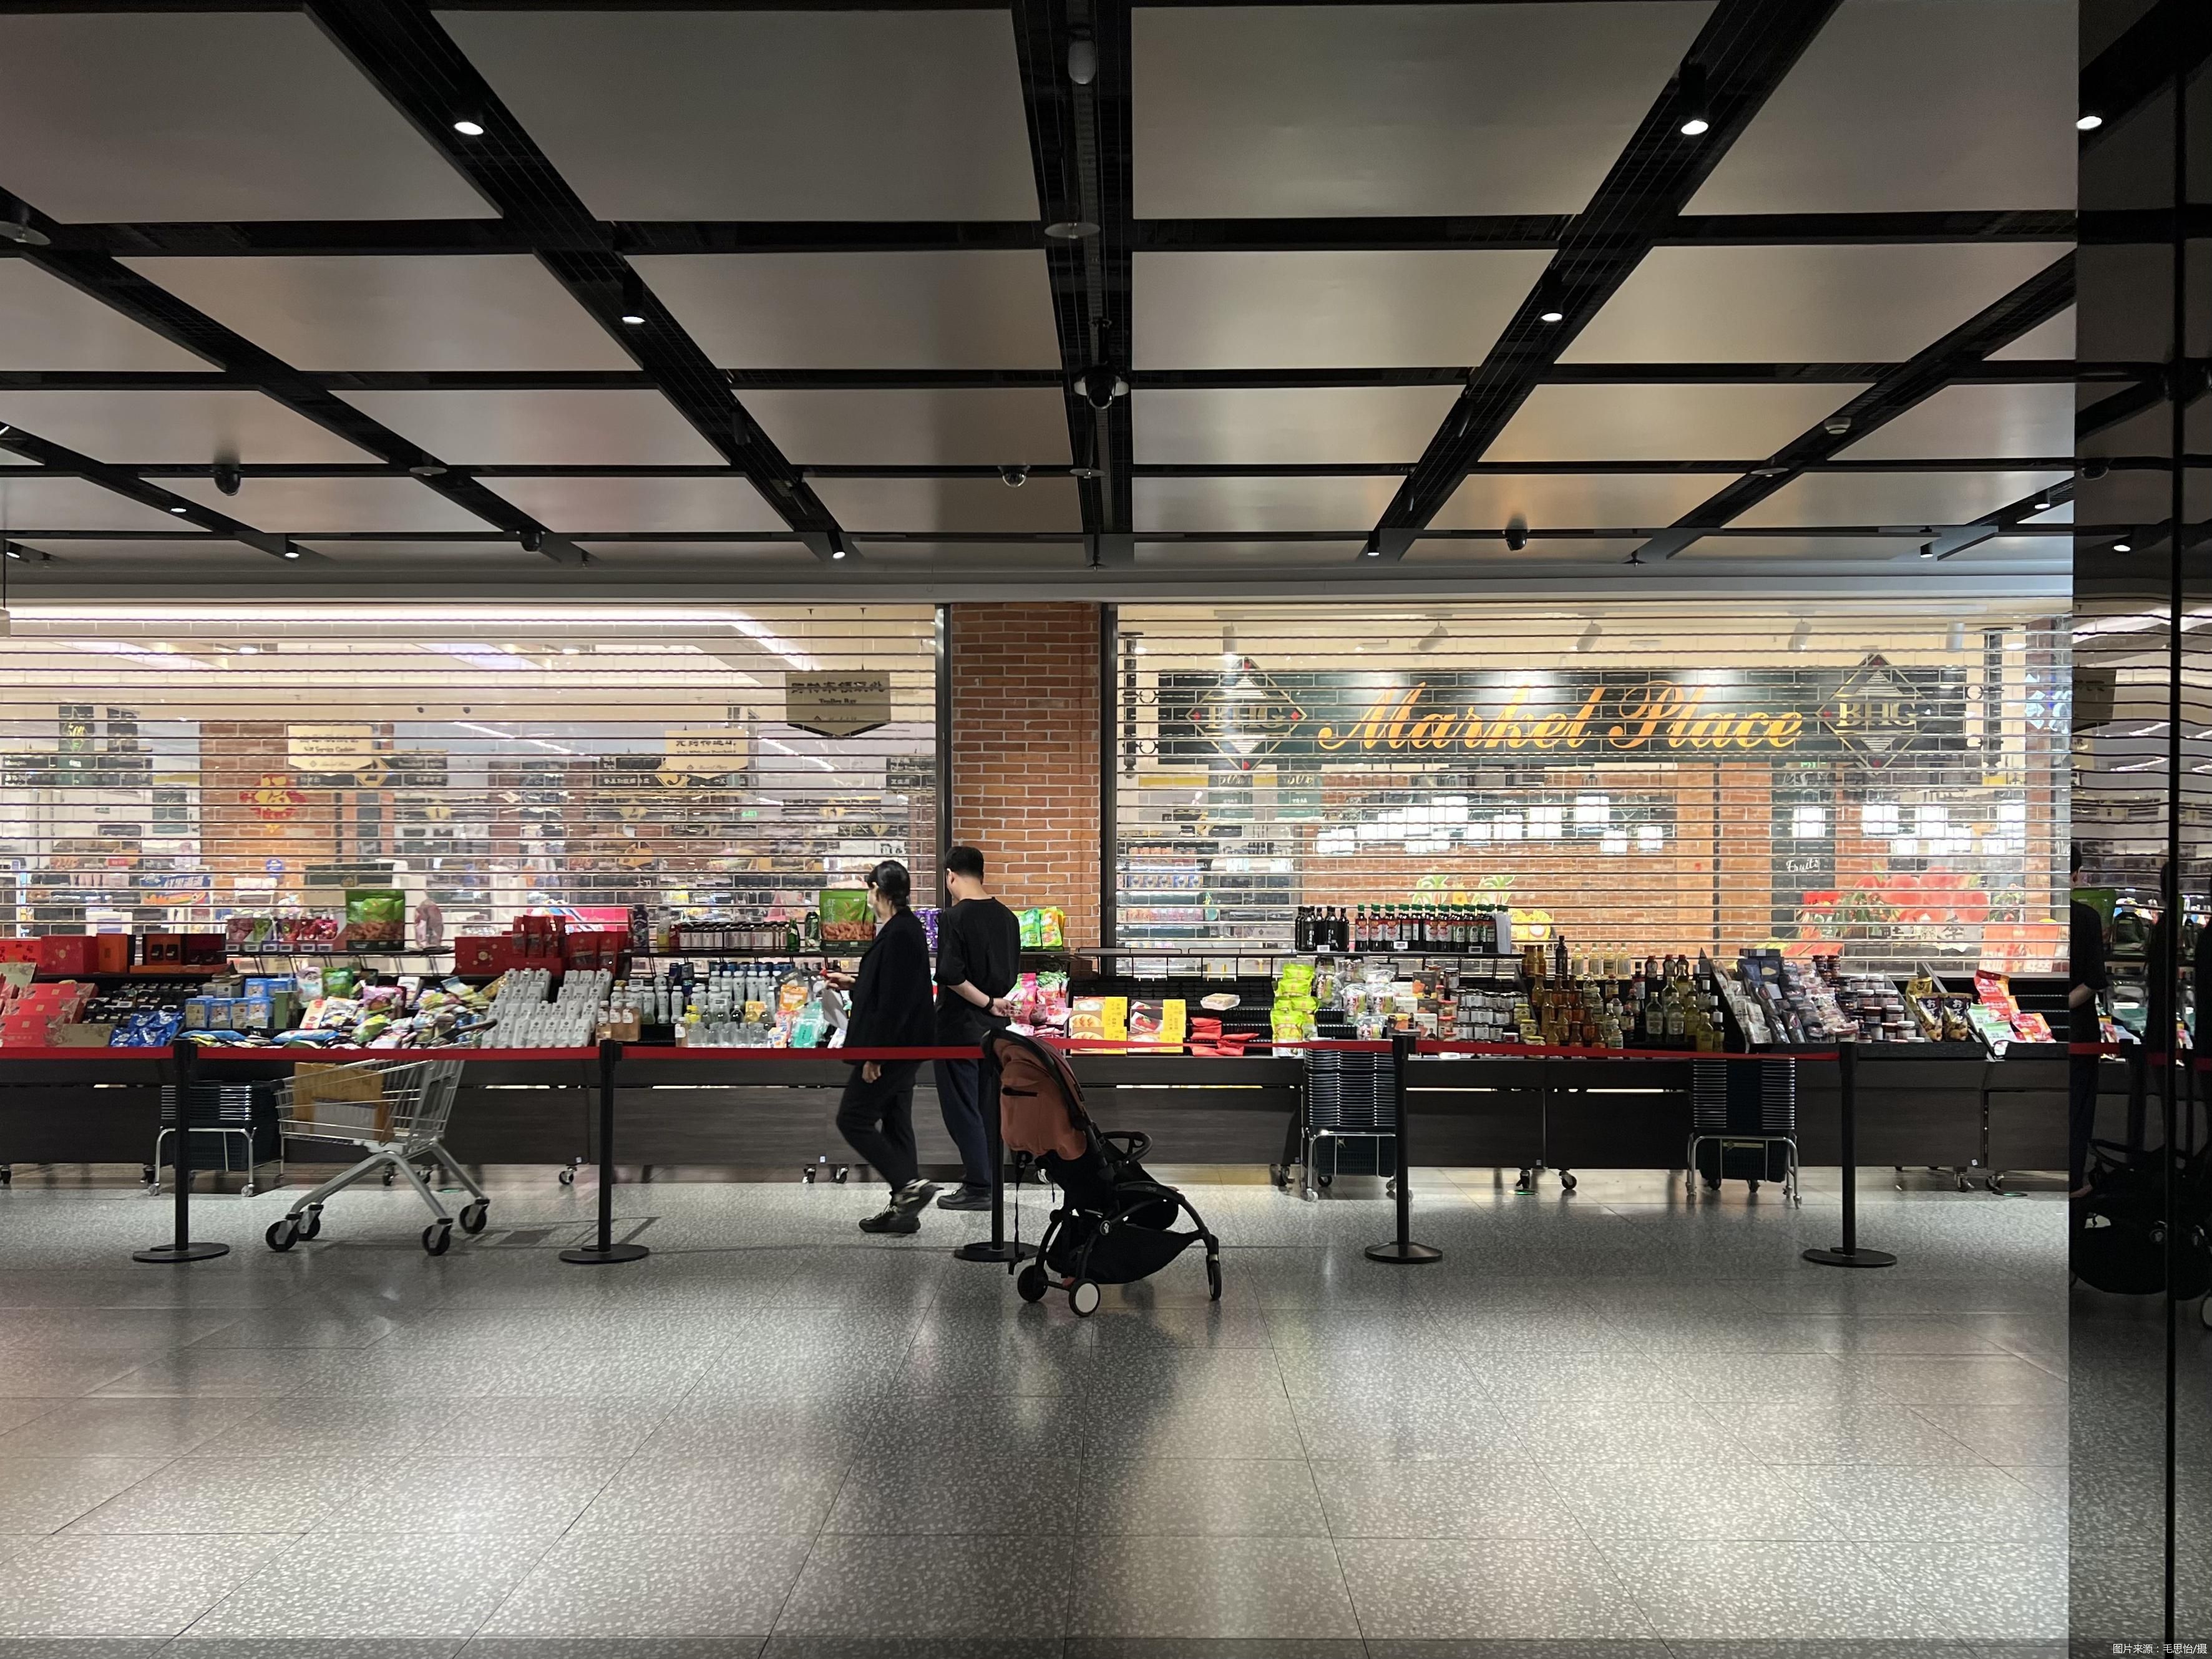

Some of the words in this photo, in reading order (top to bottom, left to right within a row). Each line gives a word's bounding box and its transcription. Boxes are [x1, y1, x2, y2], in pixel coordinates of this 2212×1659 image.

[1205, 704, 1287, 729] BHG
[1317, 680, 1605, 750] Market
[1608, 680, 1803, 750] Place
[1836, 702, 1919, 727] BHG
[1786, 858, 1820, 873] Fruits
